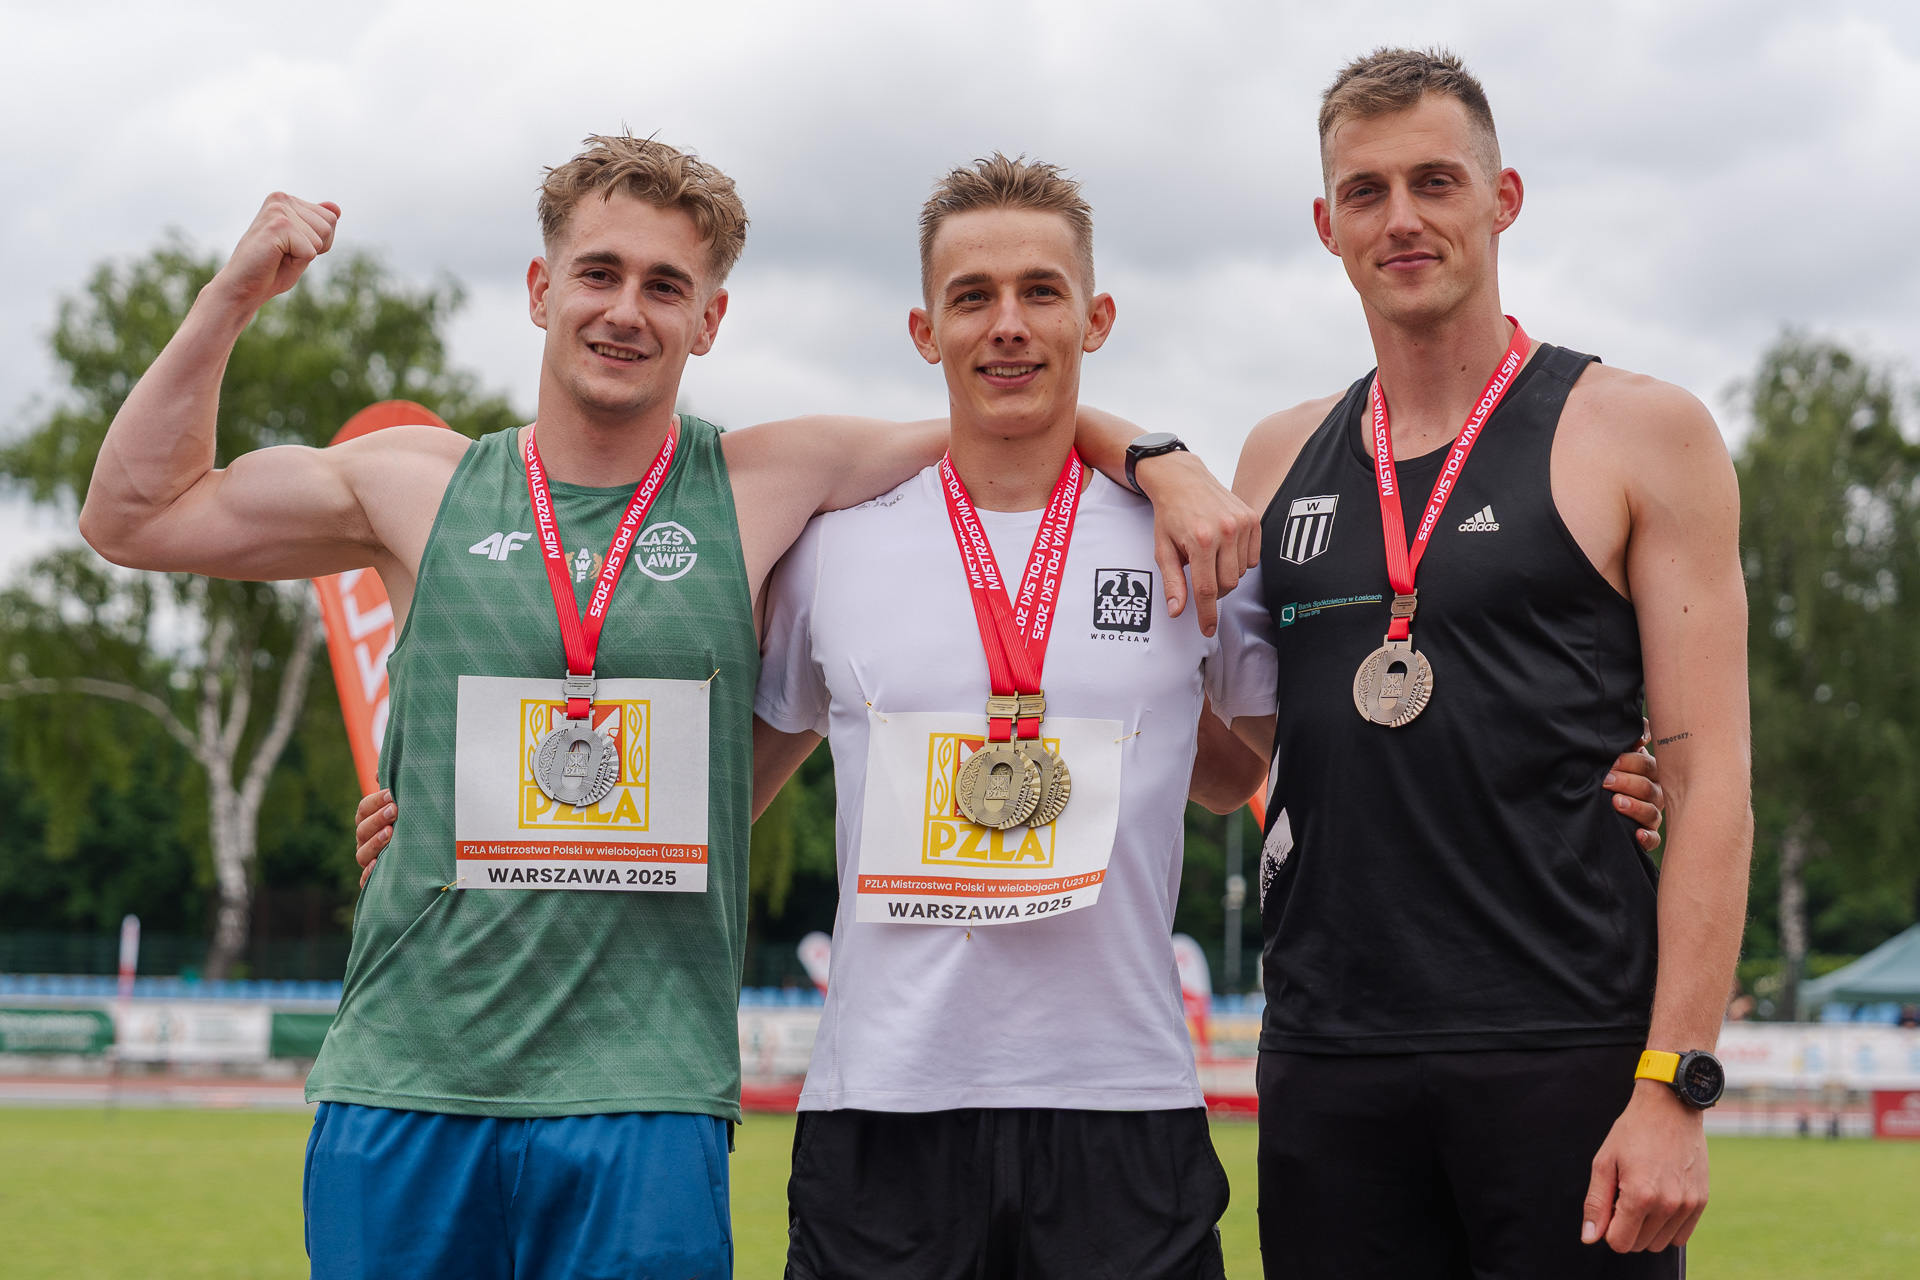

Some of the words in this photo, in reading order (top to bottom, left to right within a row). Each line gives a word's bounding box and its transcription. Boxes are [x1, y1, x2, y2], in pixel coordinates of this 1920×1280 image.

[1457, 350, 1521, 447] MISTRZOSTWA
[1373, 399, 1394, 496] MISTRZOSTWA
[624, 434, 674, 525] MISTRZOSTWA
[1432, 447, 1464, 503] POLSKI
[529, 460, 561, 559] MISTRZOSTWA
[1051, 457, 1082, 546] MISTRZOSTWA
[1306, 501, 1321, 512] W
[649, 530, 683, 546] AZS
[1418, 506, 1440, 542] 2025
[1458, 521, 1500, 532] adidas
[468, 530, 533, 561] 4F
[600, 526, 632, 580] POLSKI
[955, 497, 1001, 590] MISTRZOSTWA
[646, 554, 688, 568] AWF
[1040, 548, 1062, 602] POLSKI
[1020, 552, 1046, 607] POLSKI
[589, 580, 611, 618] 2025
[1097, 595, 1148, 611] AZS
[1298, 602, 1312, 611] Bank
[1015, 607, 1029, 636] 20
[1032, 603, 1050, 640] 2025
[1097, 609, 1147, 626] AWF
[1090, 633, 1150, 643] WROCŁAW
[463, 845, 486, 854] PZLA
[488, 845, 550, 855] Mistrzostwa
[553, 845, 583, 855] Polski
[596, 846, 659, 859] wielobojach
[661, 847, 684, 859] (U23
[691, 848, 702, 859] S)
[929, 821, 1047, 862] PZLA
[487, 867, 621, 885] WARSZAWA
[626, 869, 677, 885] 2025
[865, 879, 888, 889] PZLA
[890, 879, 953, 891] Mistrzostwa
[955, 881, 985, 892] Polski
[998, 882, 1060, 894] wielobojach
[1062, 877, 1084, 890] (U23
[1090, 872, 1100, 883] S)
[888, 902, 1020, 920] WARSZAWA
[1025, 896, 1073, 916] 2025
